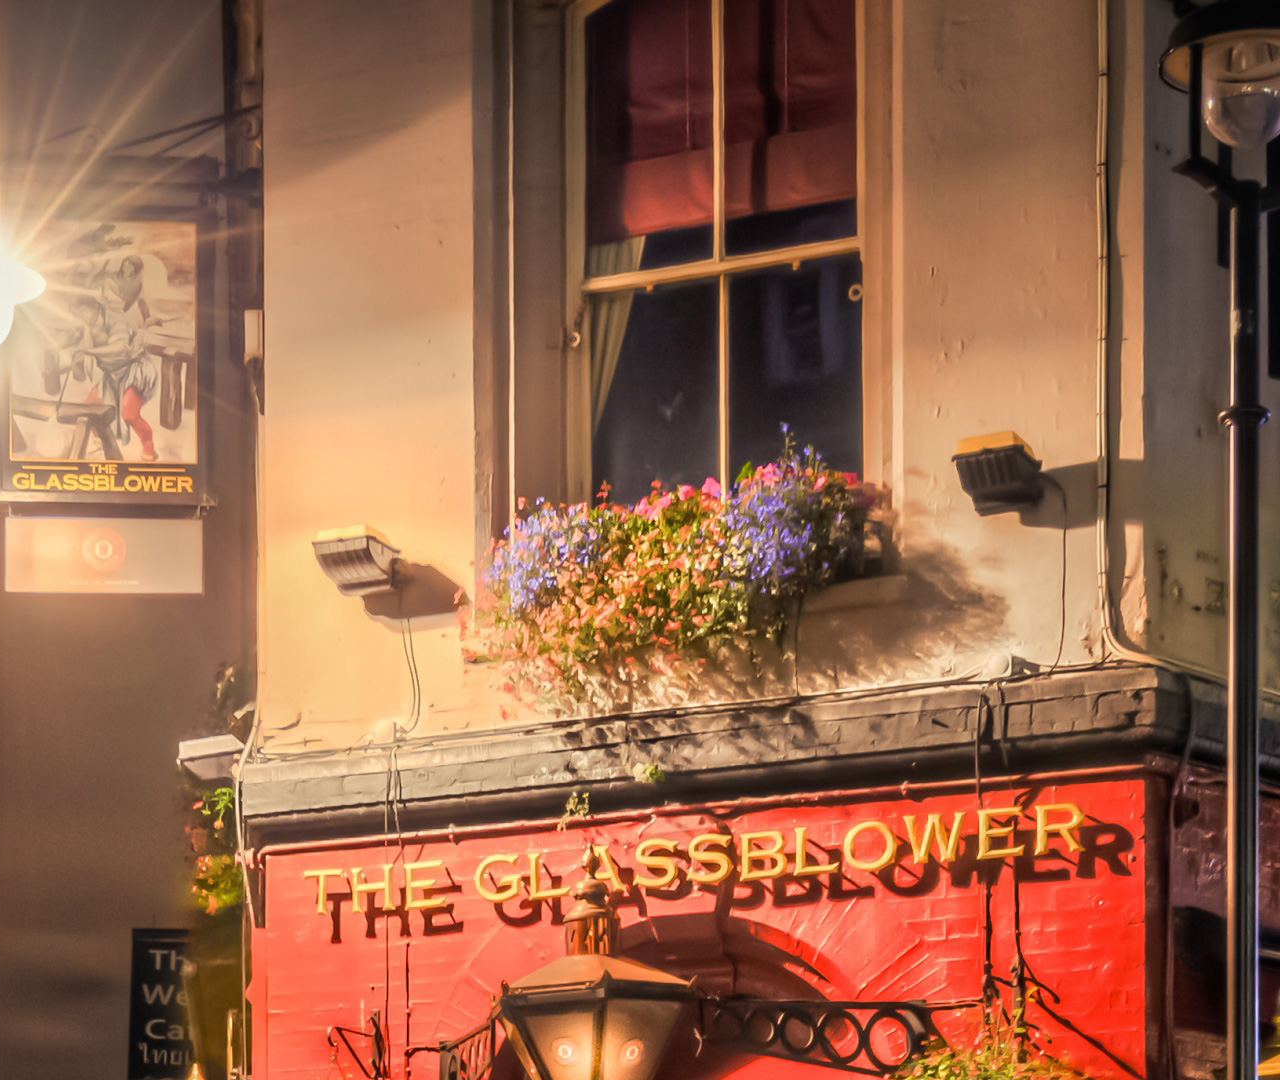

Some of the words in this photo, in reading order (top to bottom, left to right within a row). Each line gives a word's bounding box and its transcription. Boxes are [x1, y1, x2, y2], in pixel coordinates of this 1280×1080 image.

[89, 463, 118, 474] THE
[12, 472, 194, 493] GLASSBLOWER
[303, 859, 447, 915] THE
[474, 803, 1086, 901] GLASSBLOWER
[148, 949, 185, 971] Th
